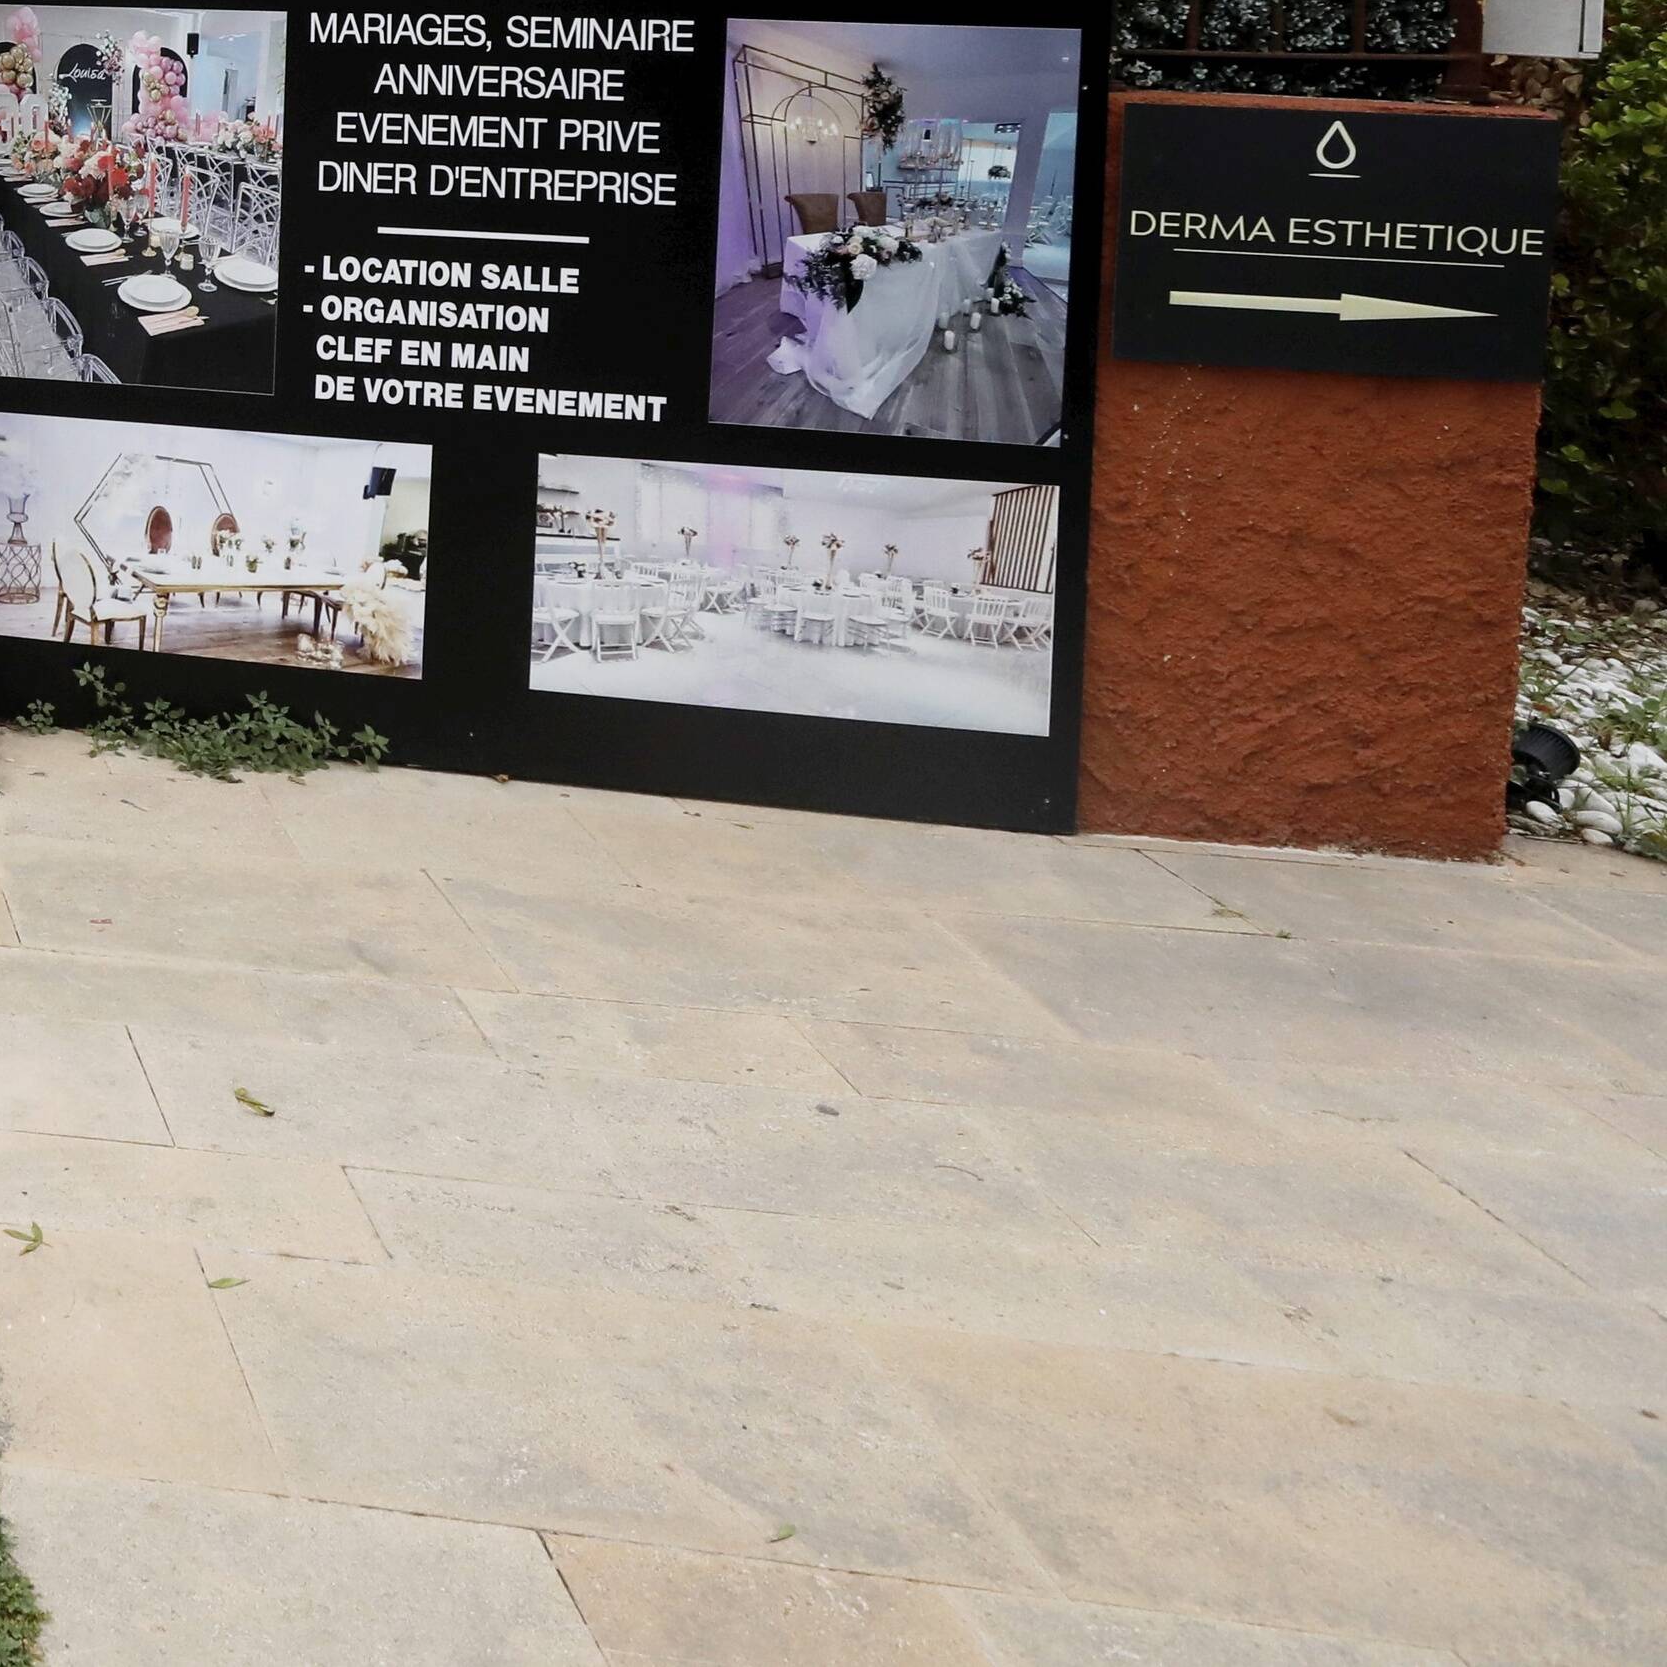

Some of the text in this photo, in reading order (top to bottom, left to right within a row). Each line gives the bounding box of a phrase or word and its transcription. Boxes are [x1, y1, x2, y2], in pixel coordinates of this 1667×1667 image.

[309, 12, 696, 53] MARIAGES, SEMINAIRE
[59, 63, 107, 82] Louisa
[373, 63, 626, 102] ANNIVERSAIRE
[335, 111, 662, 154] EVENEMENT PRIVE
[317, 160, 678, 206] DINER D'ENTREPRISE
[1130, 210, 1545, 257] DERMA ESTHETIQUE
[322, 255, 472, 289] LOCATION
[480, 265, 580, 295] SALLE
[320, 294, 550, 333] ORGANISATION
[316, 334, 530, 373] CLEF EN MAIN
[314, 374, 668, 423] DE VOTRE EVENEMENT
